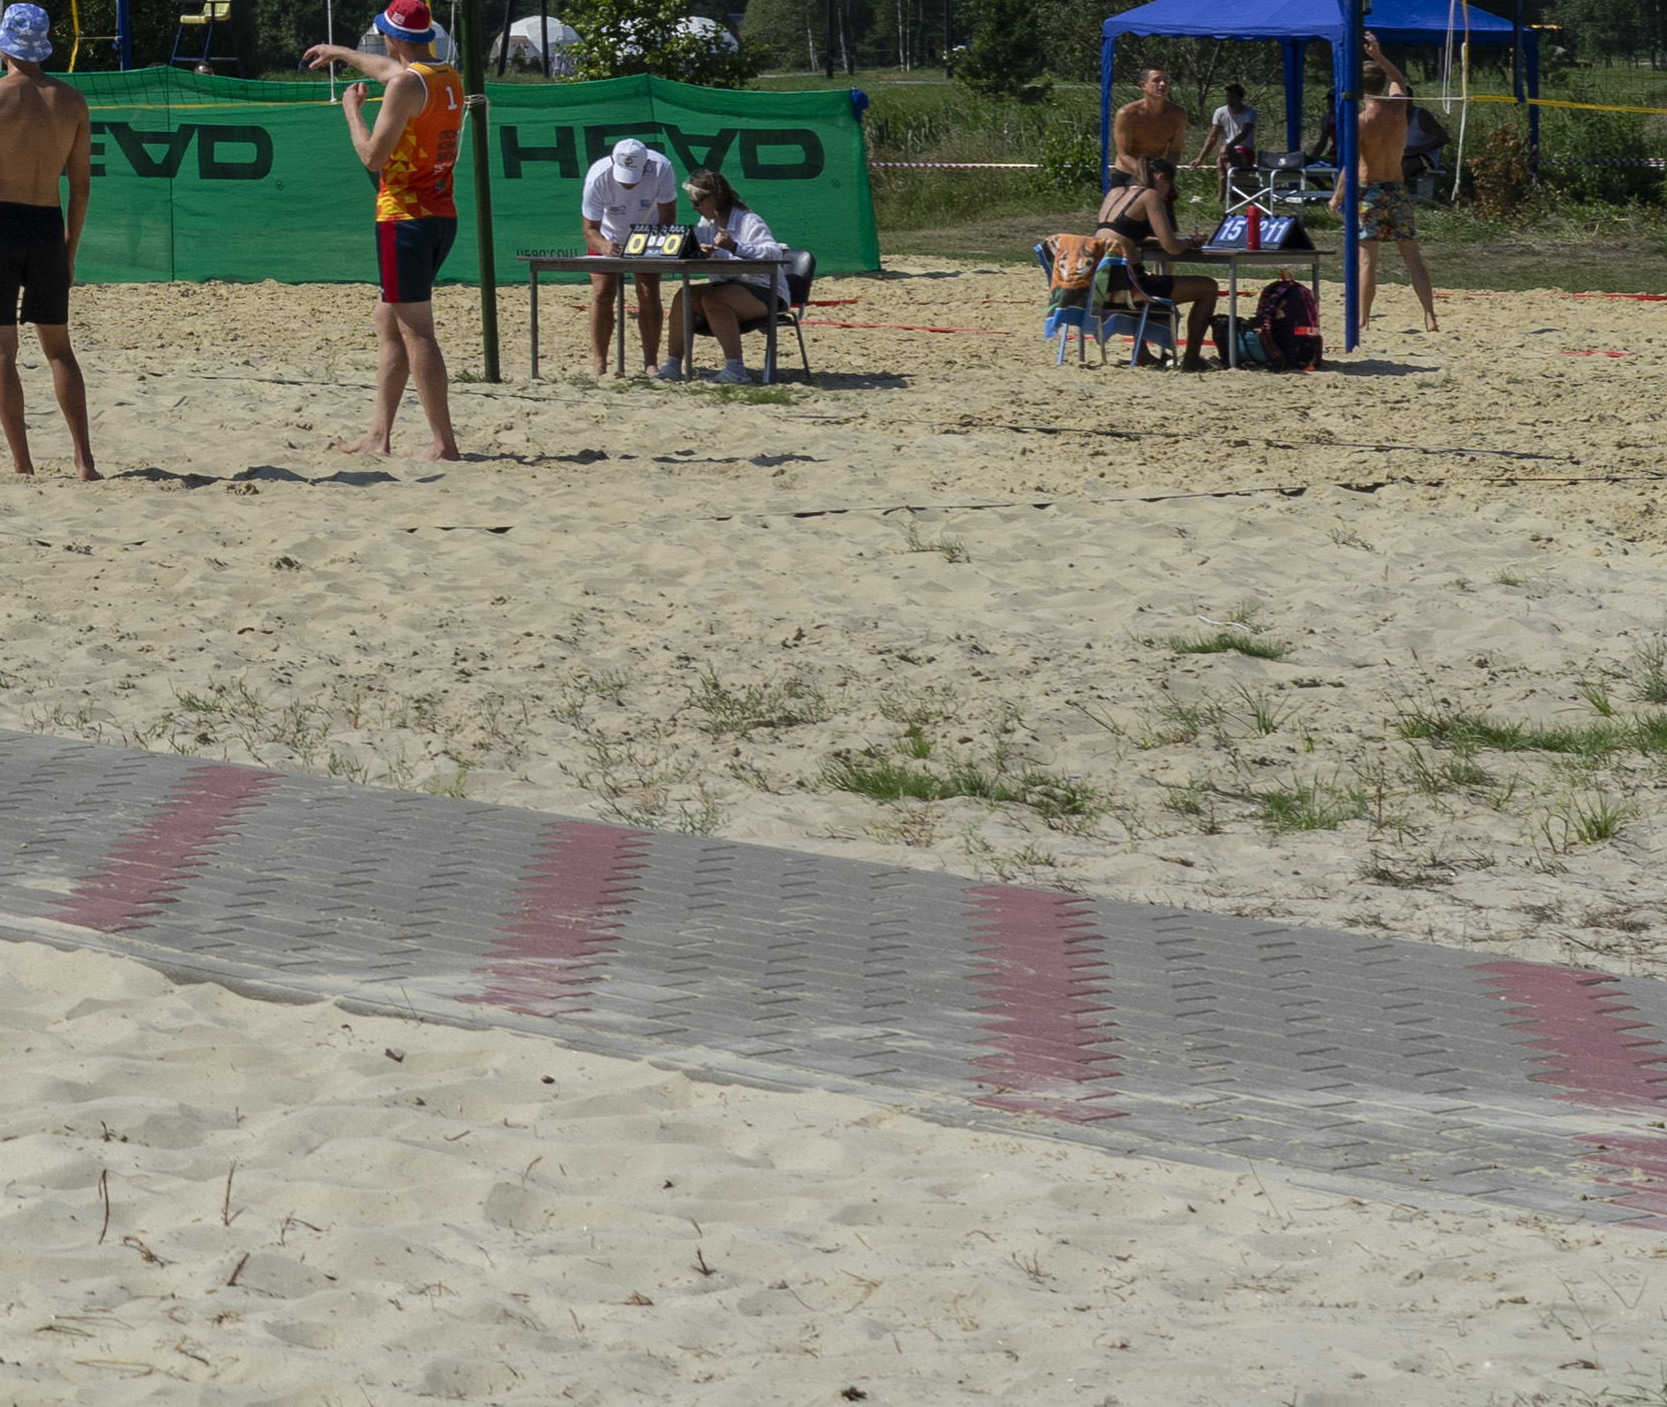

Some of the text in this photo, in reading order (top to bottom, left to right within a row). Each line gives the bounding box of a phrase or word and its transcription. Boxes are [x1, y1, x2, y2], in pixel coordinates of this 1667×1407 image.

[446, 86, 457, 110] 1
[1219, 219, 1247, 241] 15
[1263, 221, 1289, 242] 11
[628, 234, 645, 253] 0
[663, 235, 681, 254] 0
